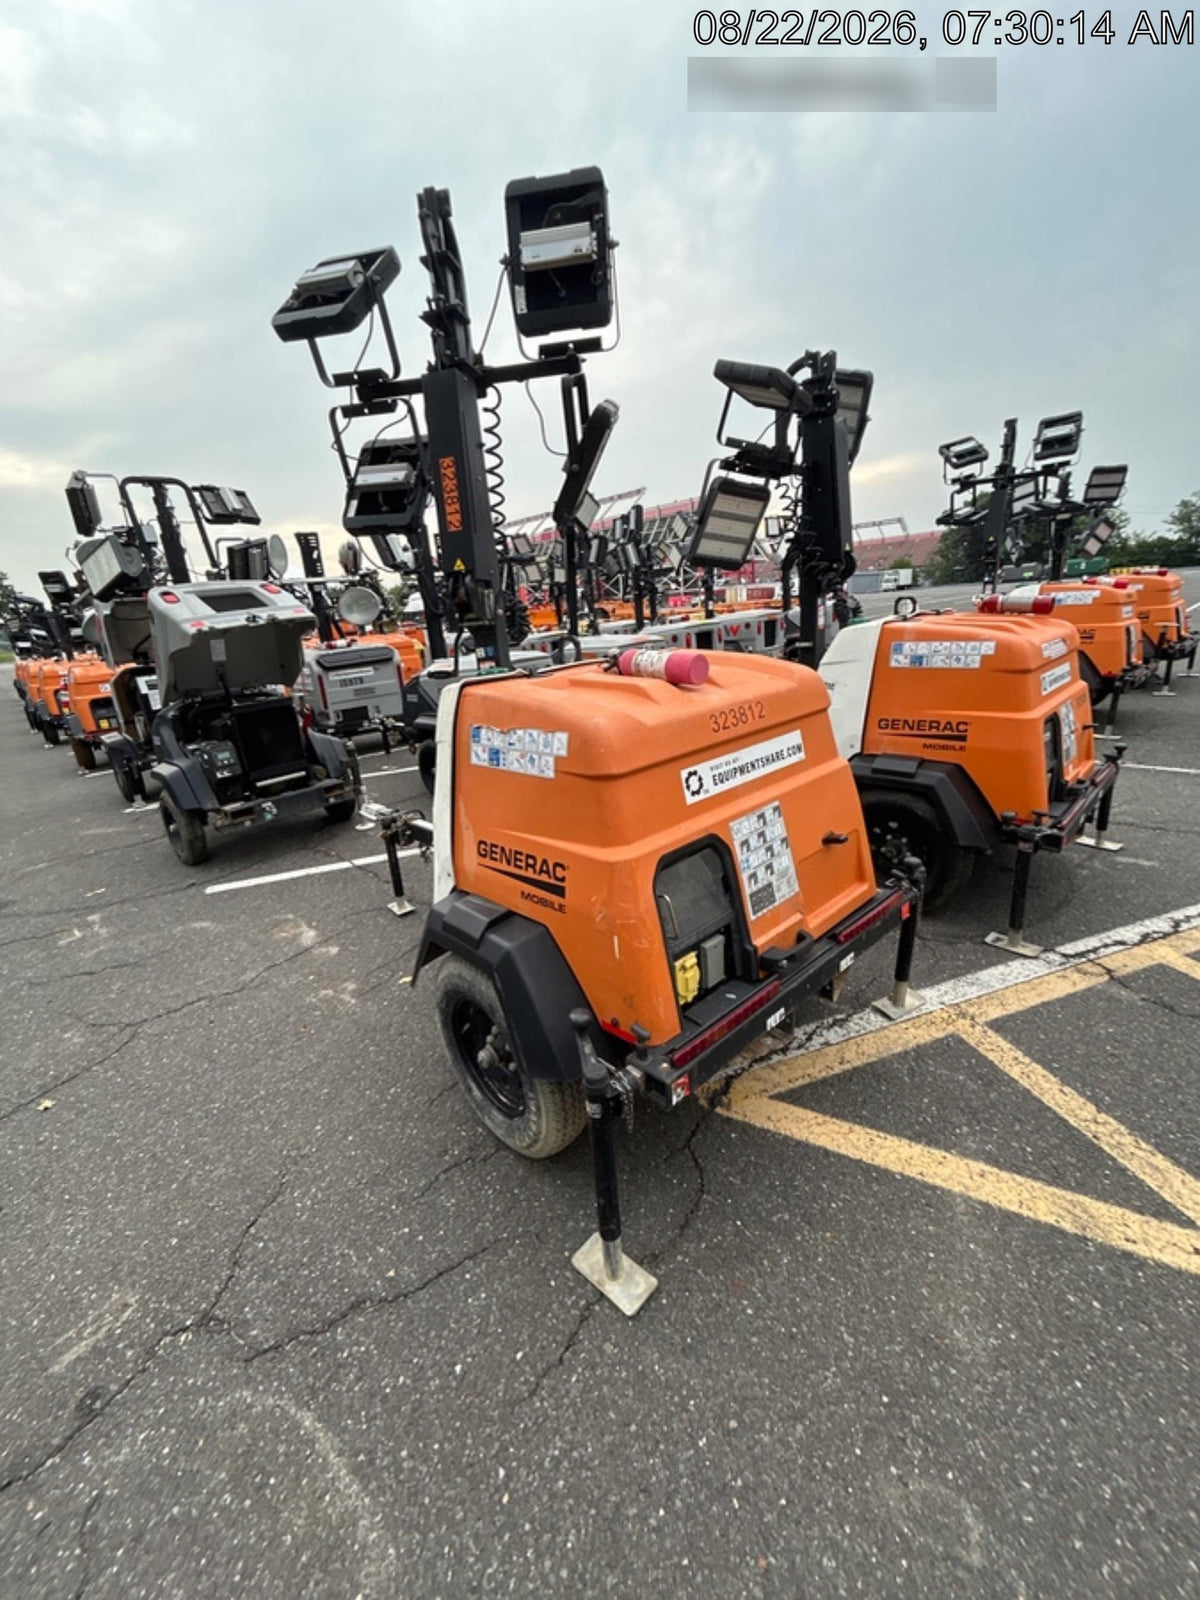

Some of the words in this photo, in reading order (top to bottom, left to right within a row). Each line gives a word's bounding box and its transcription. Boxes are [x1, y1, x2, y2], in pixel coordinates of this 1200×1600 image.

[441, 459, 462, 529] 323812
[710, 701, 766, 733] 323812
[877, 718, 969, 733] GENERAC
[922, 742, 967, 752] MOBILE
[712, 743, 803, 786] EQUIPMENTSHARE.COM
[477, 839, 567, 883] GENERAC
[520, 890, 567, 914] MOBILE
